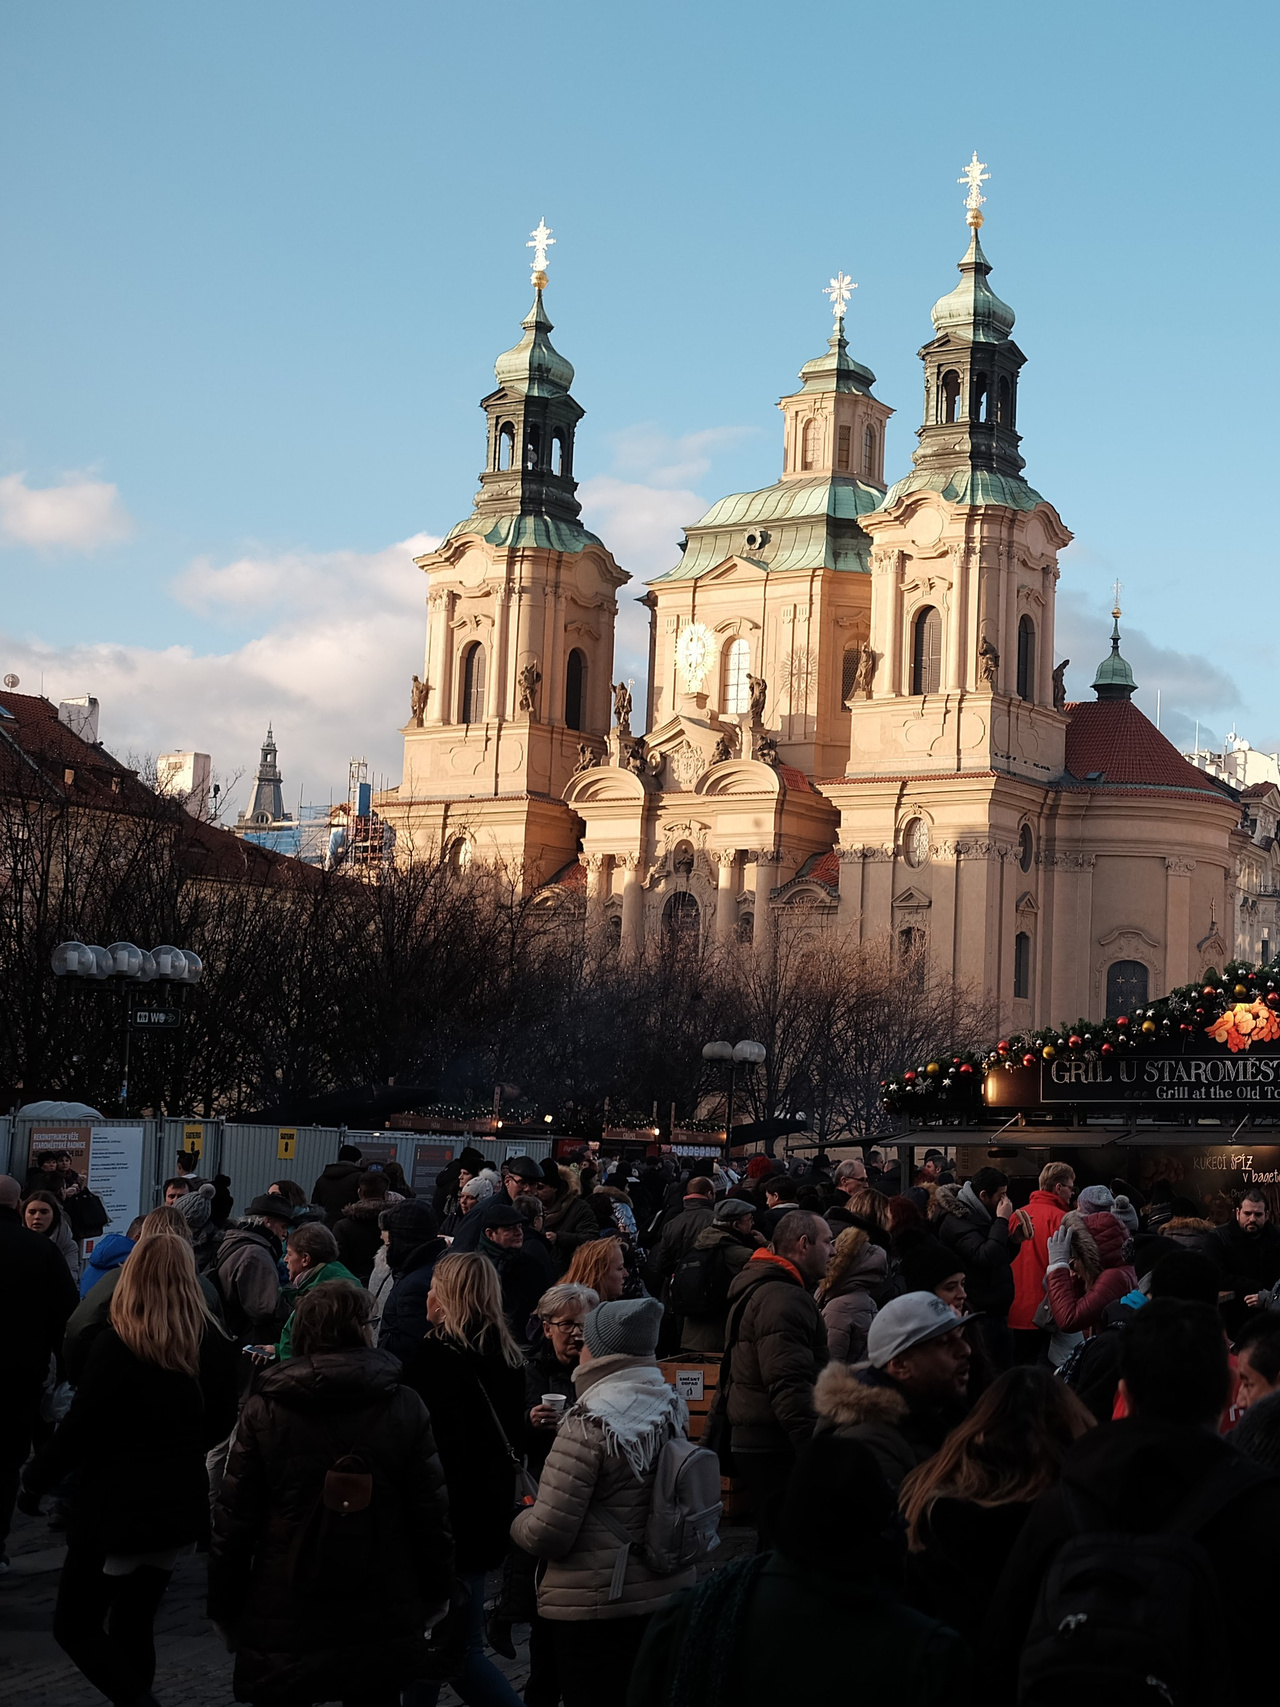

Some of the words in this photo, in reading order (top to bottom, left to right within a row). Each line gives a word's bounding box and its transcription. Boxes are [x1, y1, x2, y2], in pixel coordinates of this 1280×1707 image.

[1051, 1059, 1112, 1084] GRIL
[1119, 1060, 1140, 1083] U
[1155, 1085, 1189, 1099] Grill
[1192, 1087, 1206, 1099] at
[1209, 1085, 1233, 1099] the
[1236, 1085, 1260, 1099] Old
[1193, 1148, 1227, 1170] KUŘECÍ
[1230, 1153, 1254, 1170] ŠPÍZ
[1242, 1172, 1249, 1183] v
